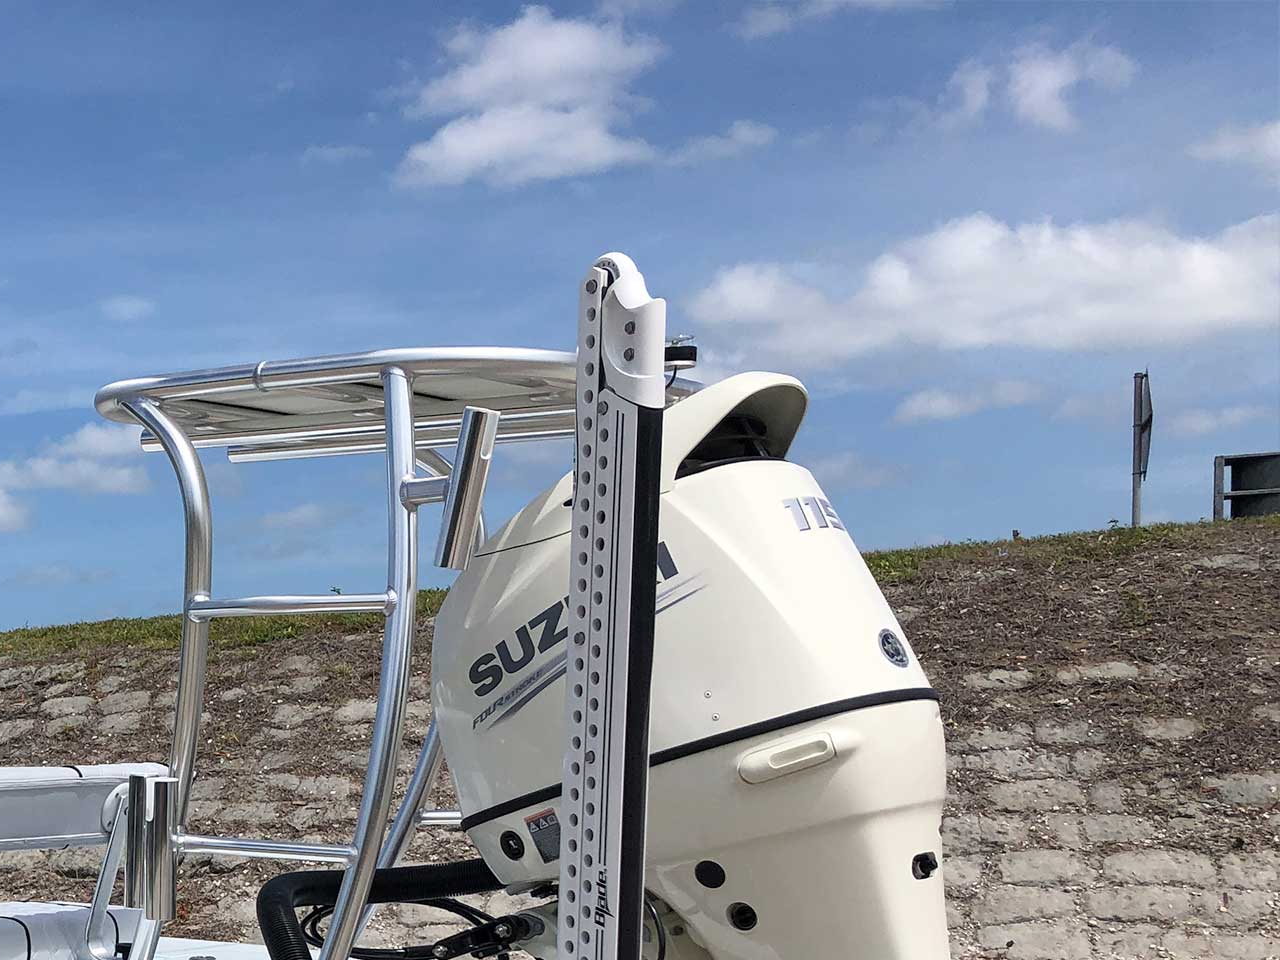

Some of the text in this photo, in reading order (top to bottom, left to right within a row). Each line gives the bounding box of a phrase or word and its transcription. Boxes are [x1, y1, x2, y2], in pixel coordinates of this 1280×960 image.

[782, 496, 845, 531] 115
[469, 541, 679, 697] SUZI
[594, 870, 615, 928] Blade
